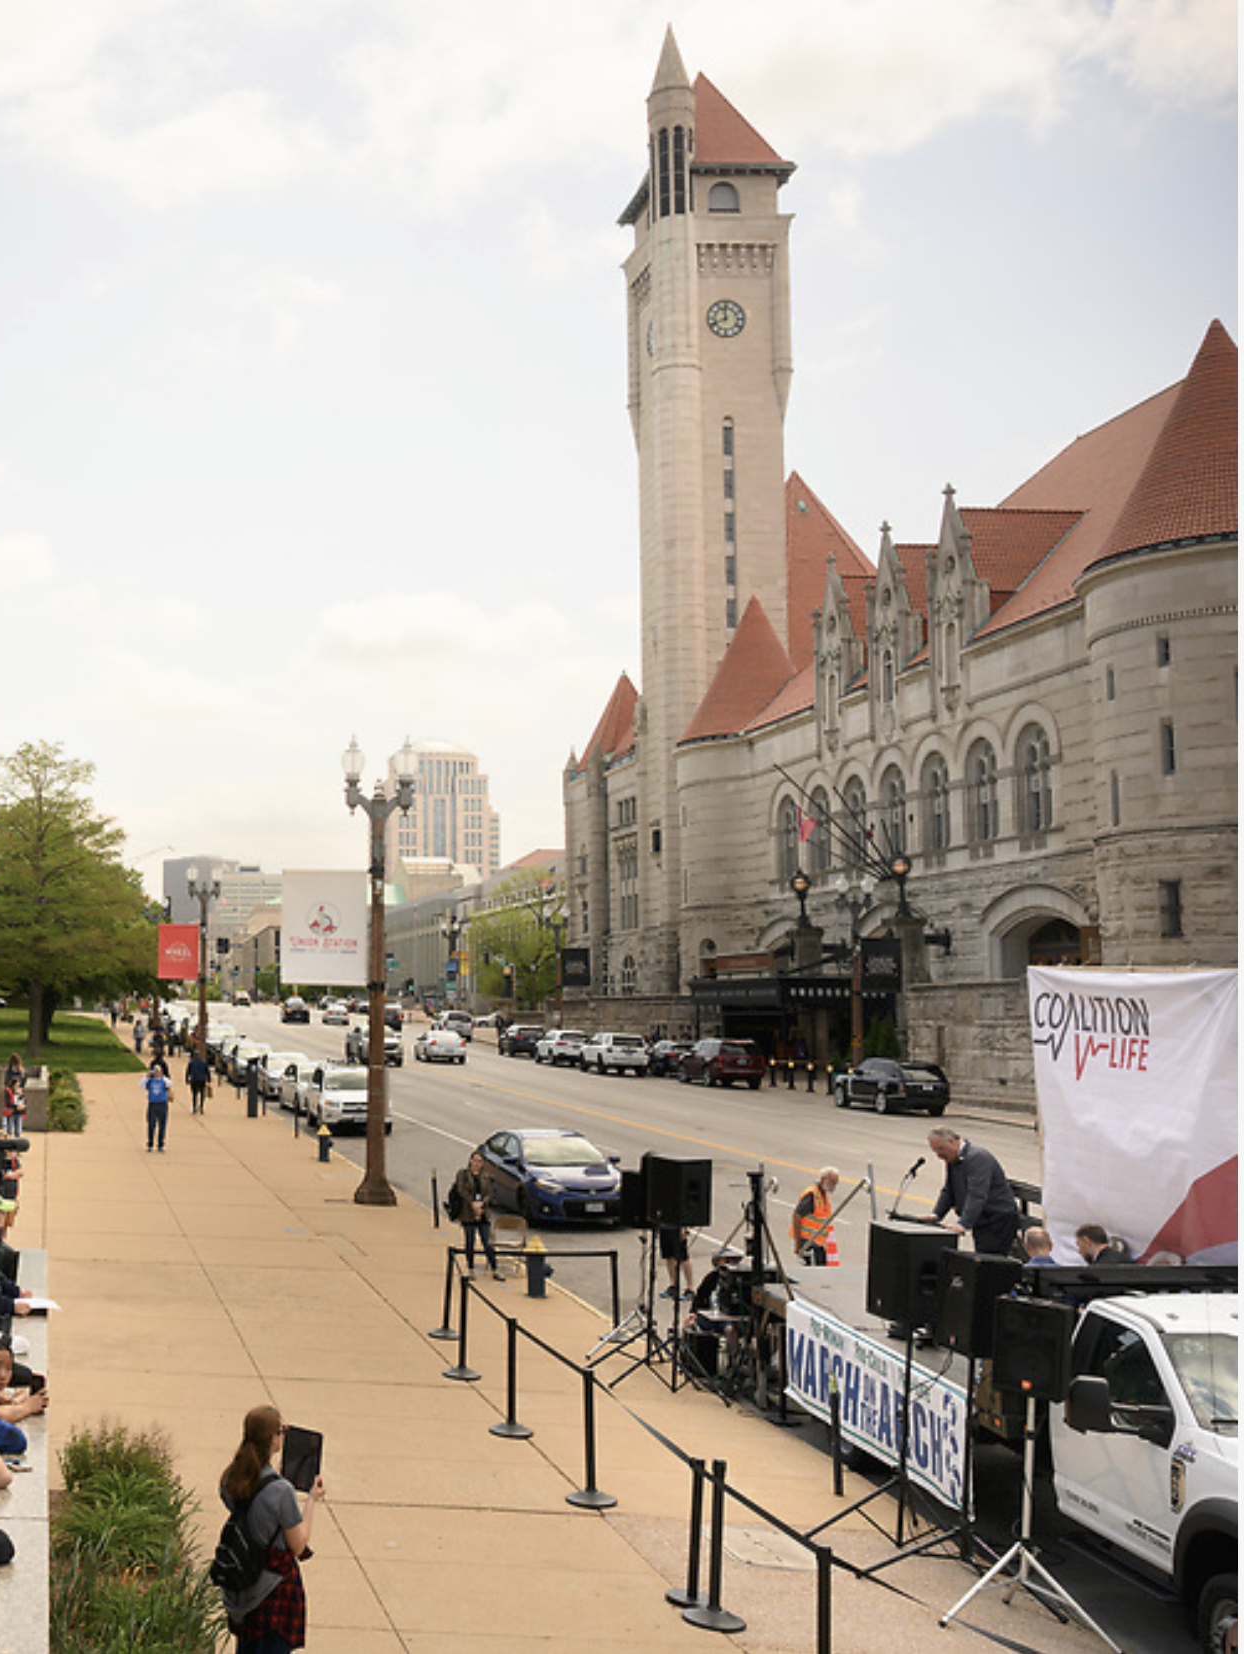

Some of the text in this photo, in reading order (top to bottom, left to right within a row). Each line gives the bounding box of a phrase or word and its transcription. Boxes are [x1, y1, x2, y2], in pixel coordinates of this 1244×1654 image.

[322, 937, 358, 949] STATION
[1034, 992, 1149, 1061] COALITION
[1109, 1037, 1150, 1072] LIFE
[788, 1328, 860, 1426] MARCH
